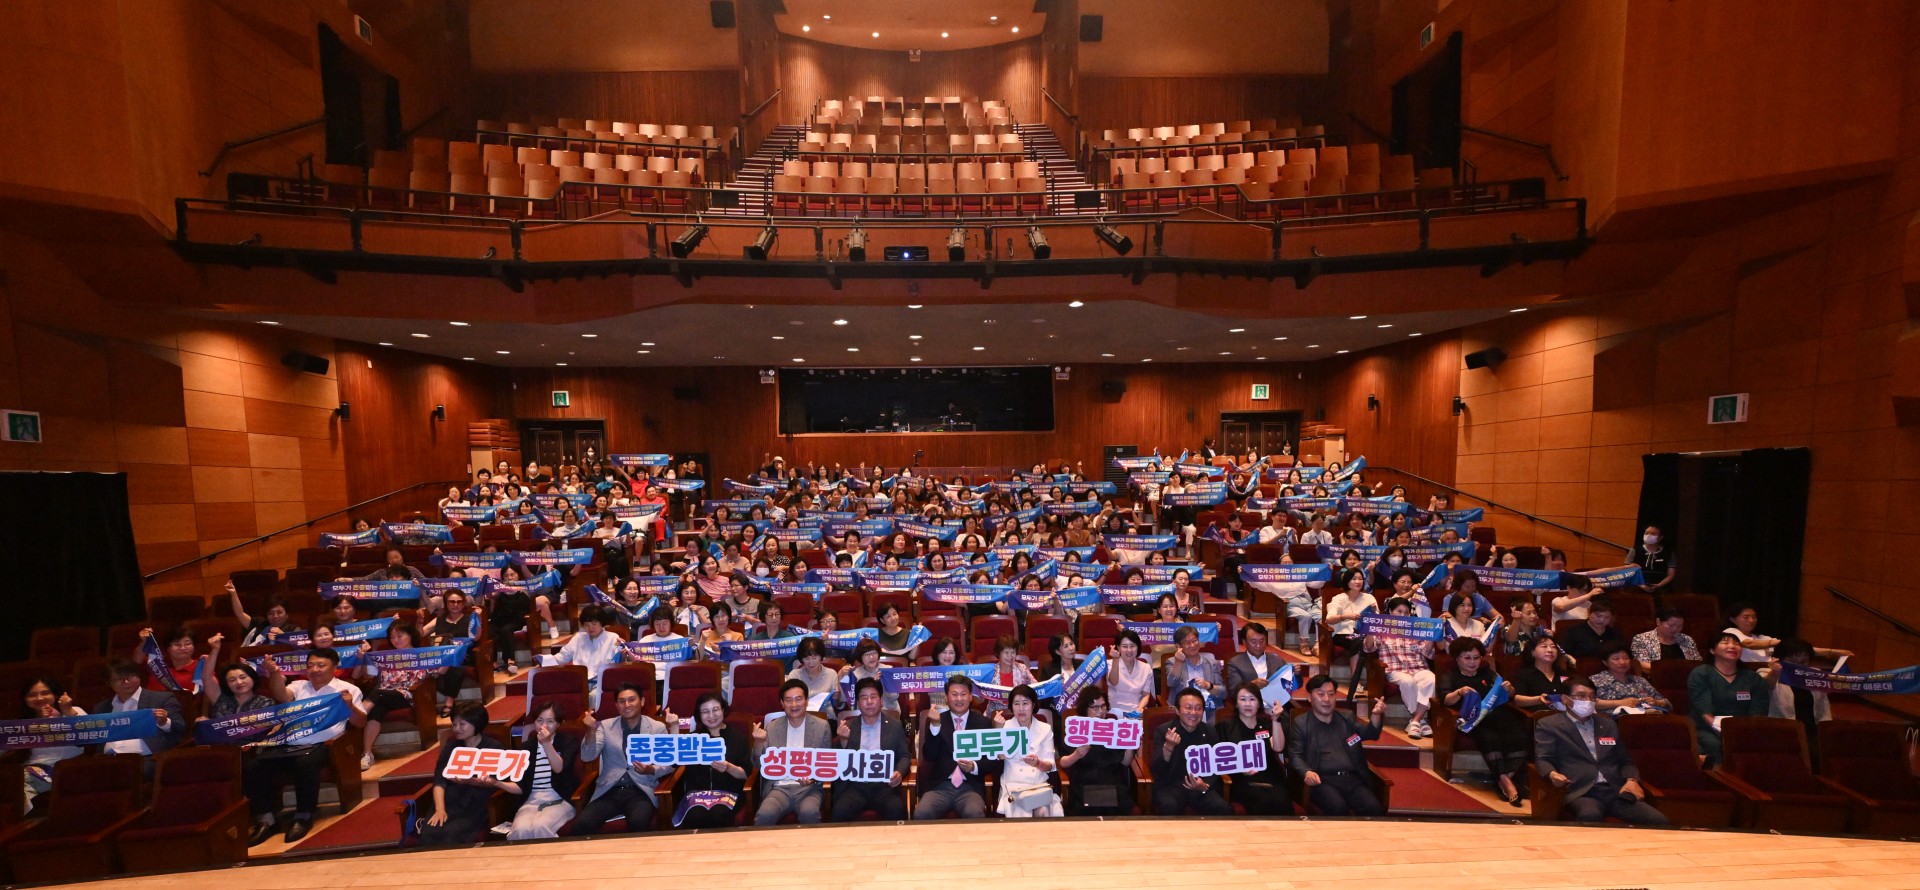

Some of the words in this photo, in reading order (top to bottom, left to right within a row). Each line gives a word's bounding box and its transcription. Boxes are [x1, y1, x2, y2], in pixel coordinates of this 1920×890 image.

[7, 734, 41, 745] 모두가
[78, 729, 109, 740] 해운대
[956, 731, 1029, 759] 모두가
[1068, 719, 1140, 747] 행복한
[629, 736, 723, 763] 존중받는
[1188, 743, 1264, 775] 해운대
[446, 750, 527, 778] 모두가
[764, 750, 838, 779] 성평등
[842, 753, 890, 780] 사회
